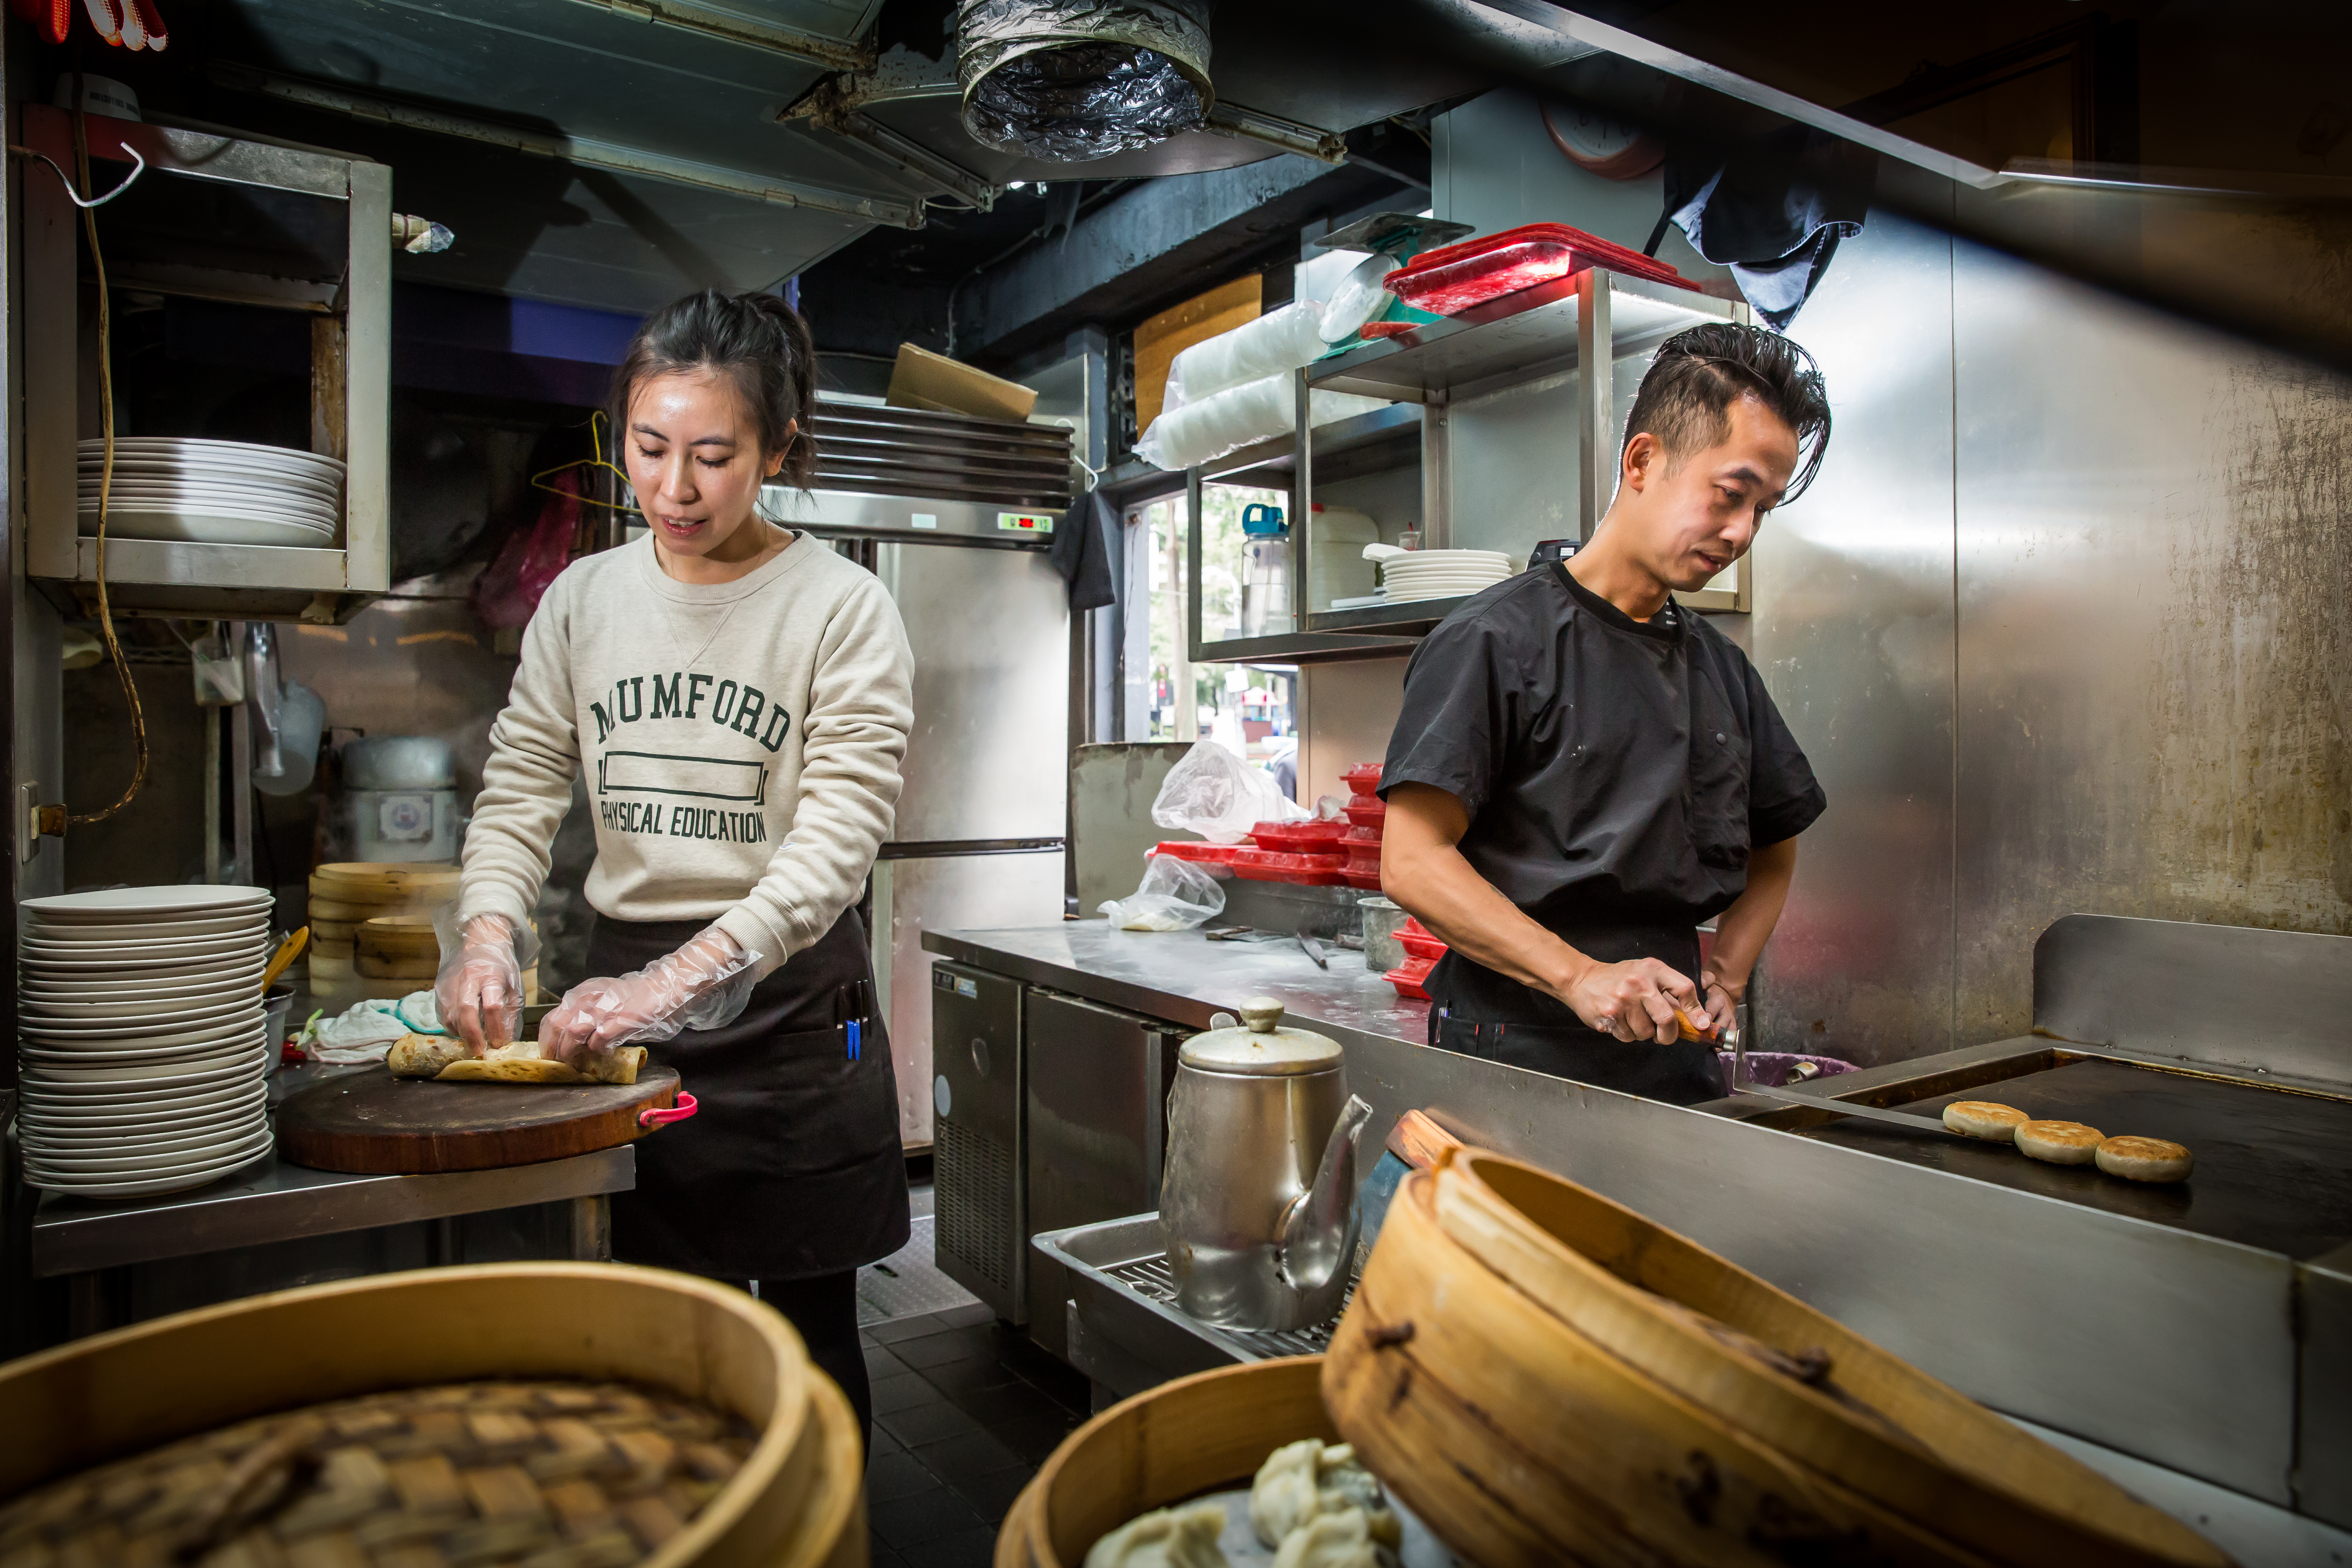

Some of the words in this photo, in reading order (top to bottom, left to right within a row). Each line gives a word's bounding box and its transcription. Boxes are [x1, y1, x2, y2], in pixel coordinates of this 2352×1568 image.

[590, 672, 791, 753] MUMFORD
[601, 800, 663, 834] PHYSICAL
[670, 806, 767, 844] EDUCATION
